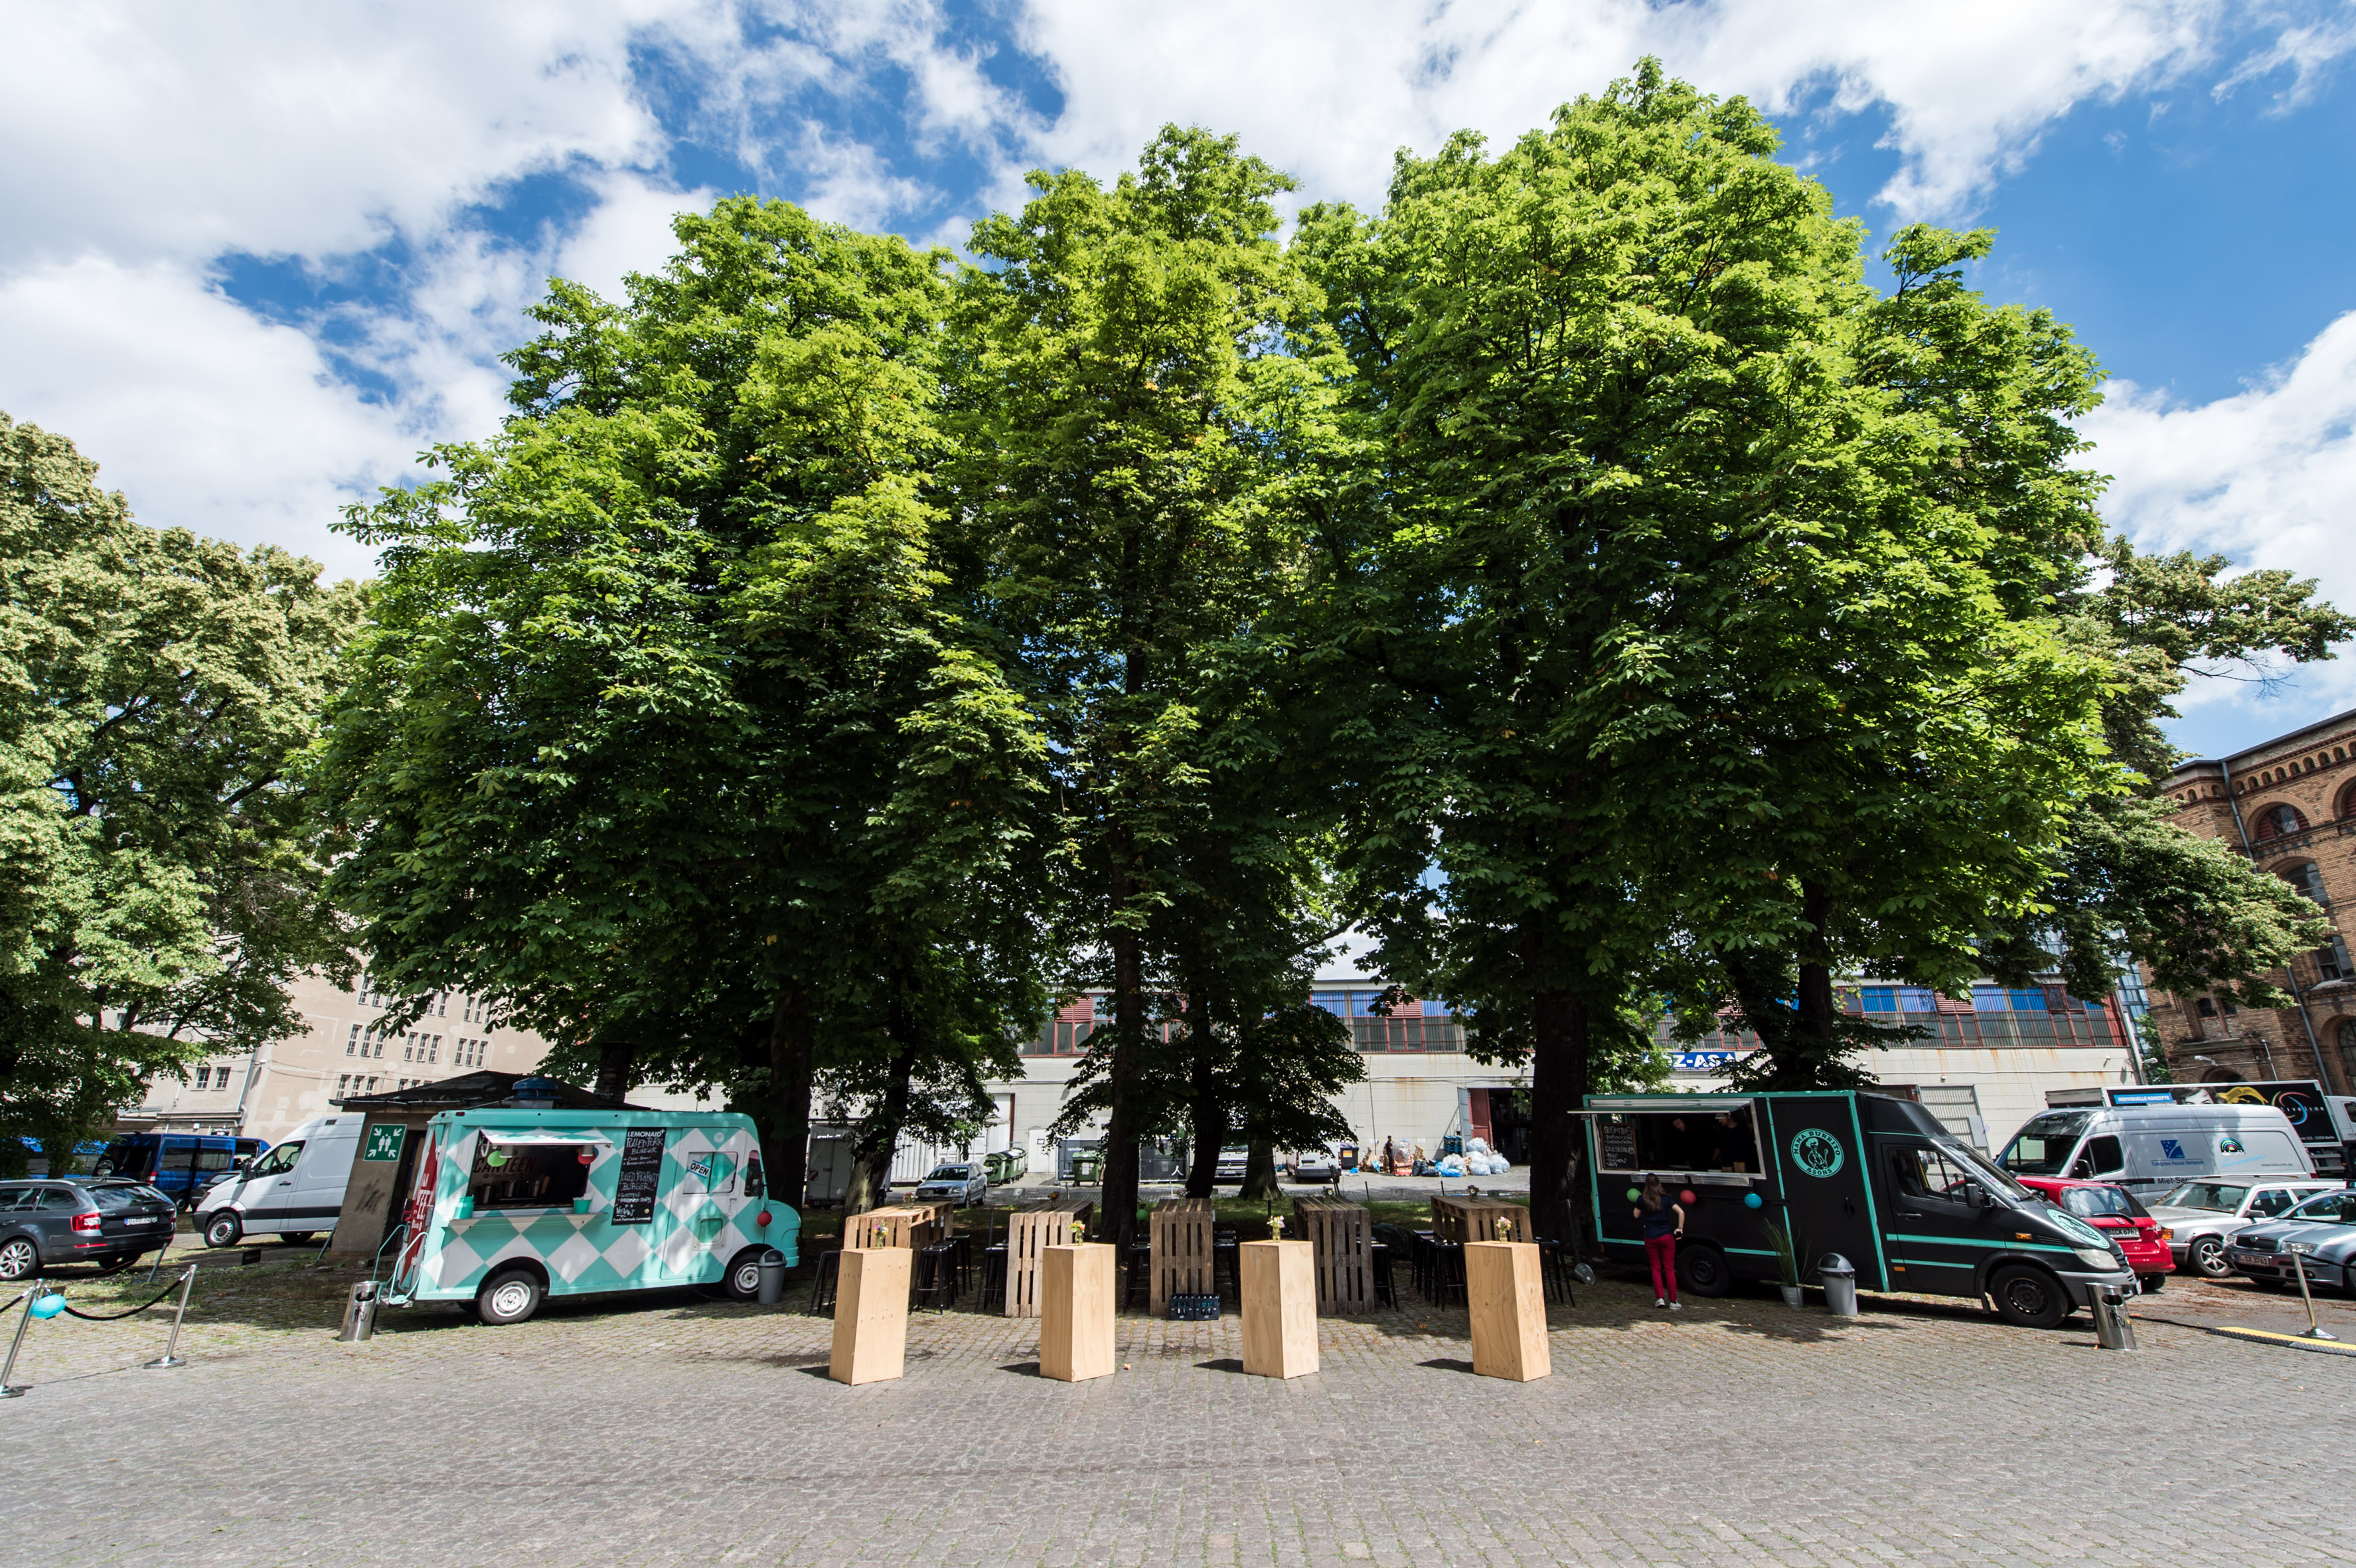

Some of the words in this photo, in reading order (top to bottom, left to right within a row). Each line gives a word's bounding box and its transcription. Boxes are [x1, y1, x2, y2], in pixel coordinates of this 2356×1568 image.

[626, 1137, 647, 1148] PULLED
[1794, 1134, 1806, 1154] MAMA
[1808, 1131, 1841, 1156] BURRITO
[690, 1162, 710, 1176] OPEN
